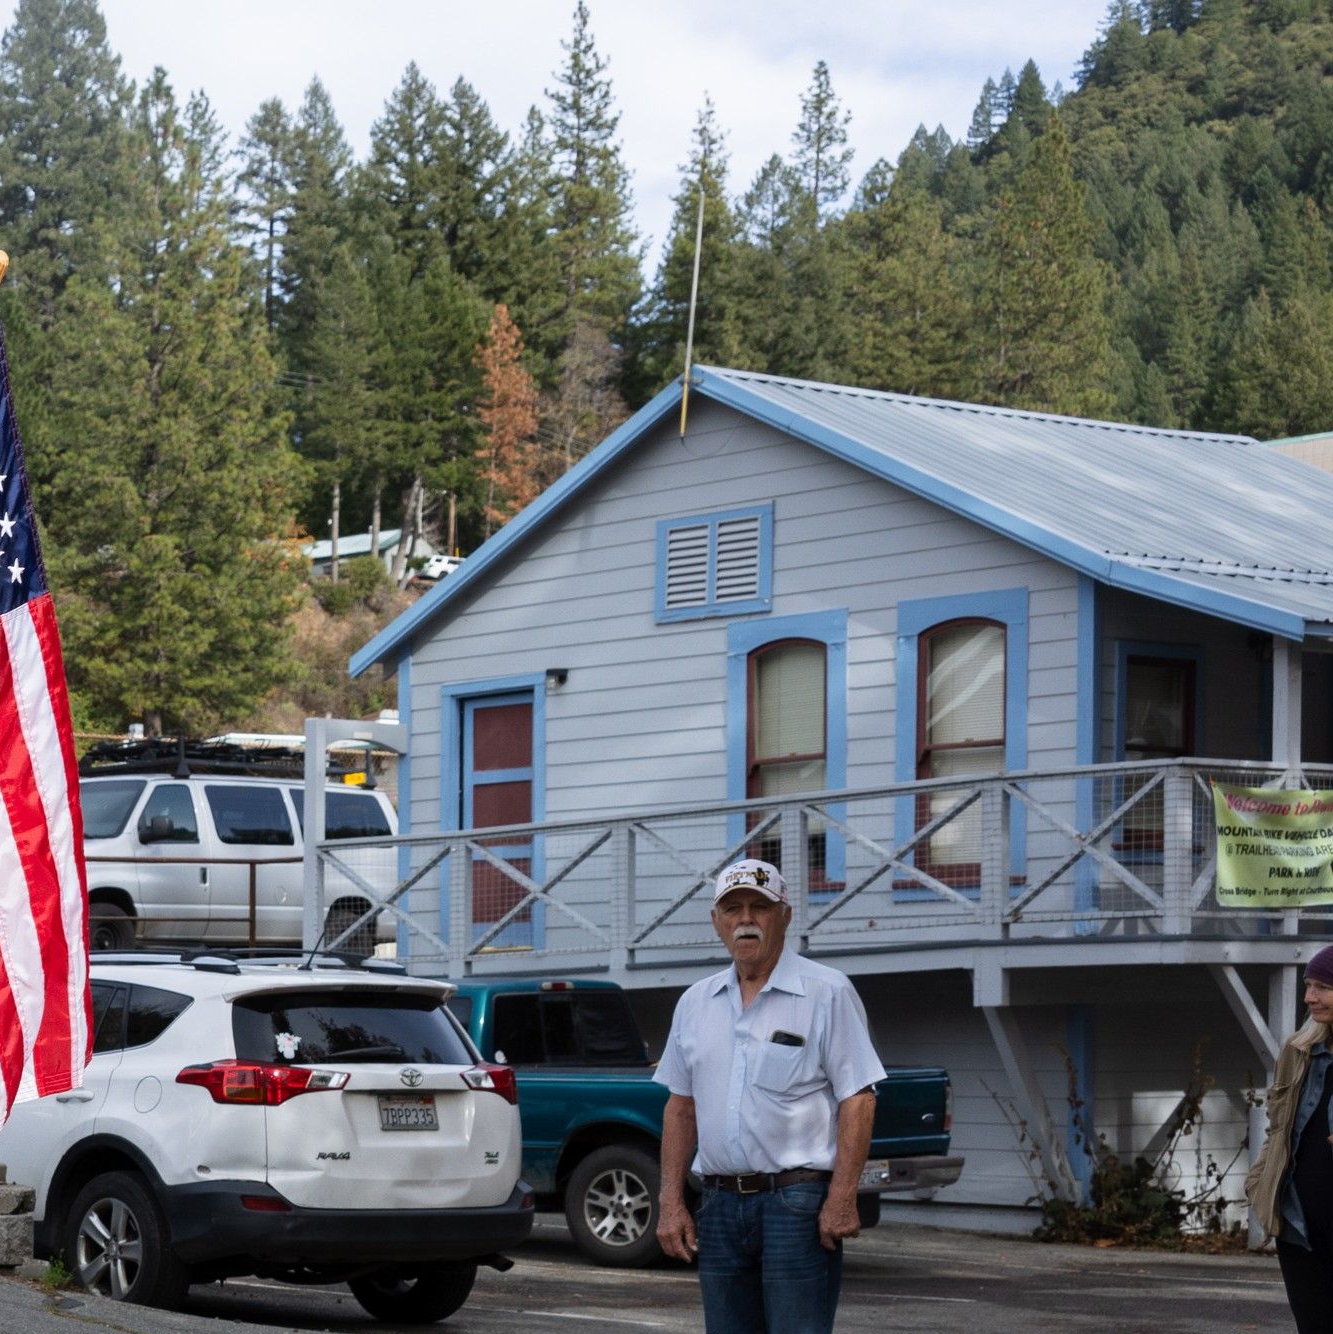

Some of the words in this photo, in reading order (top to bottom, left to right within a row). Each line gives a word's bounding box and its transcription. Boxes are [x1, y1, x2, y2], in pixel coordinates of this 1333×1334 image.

[1226, 793, 1291, 815] Welcome
[1295, 802, 1308, 815] to
[1269, 866, 1294, 878] PARK
[1219, 887, 1234, 896] Cross
[1235, 887, 1257, 897] Bridge
[1263, 887, 1280, 896] Turn
[1281, 887, 1299, 897] Right
[382, 1108, 434, 1126] 7BPP335
[315, 1151, 351, 1161] RAV4
